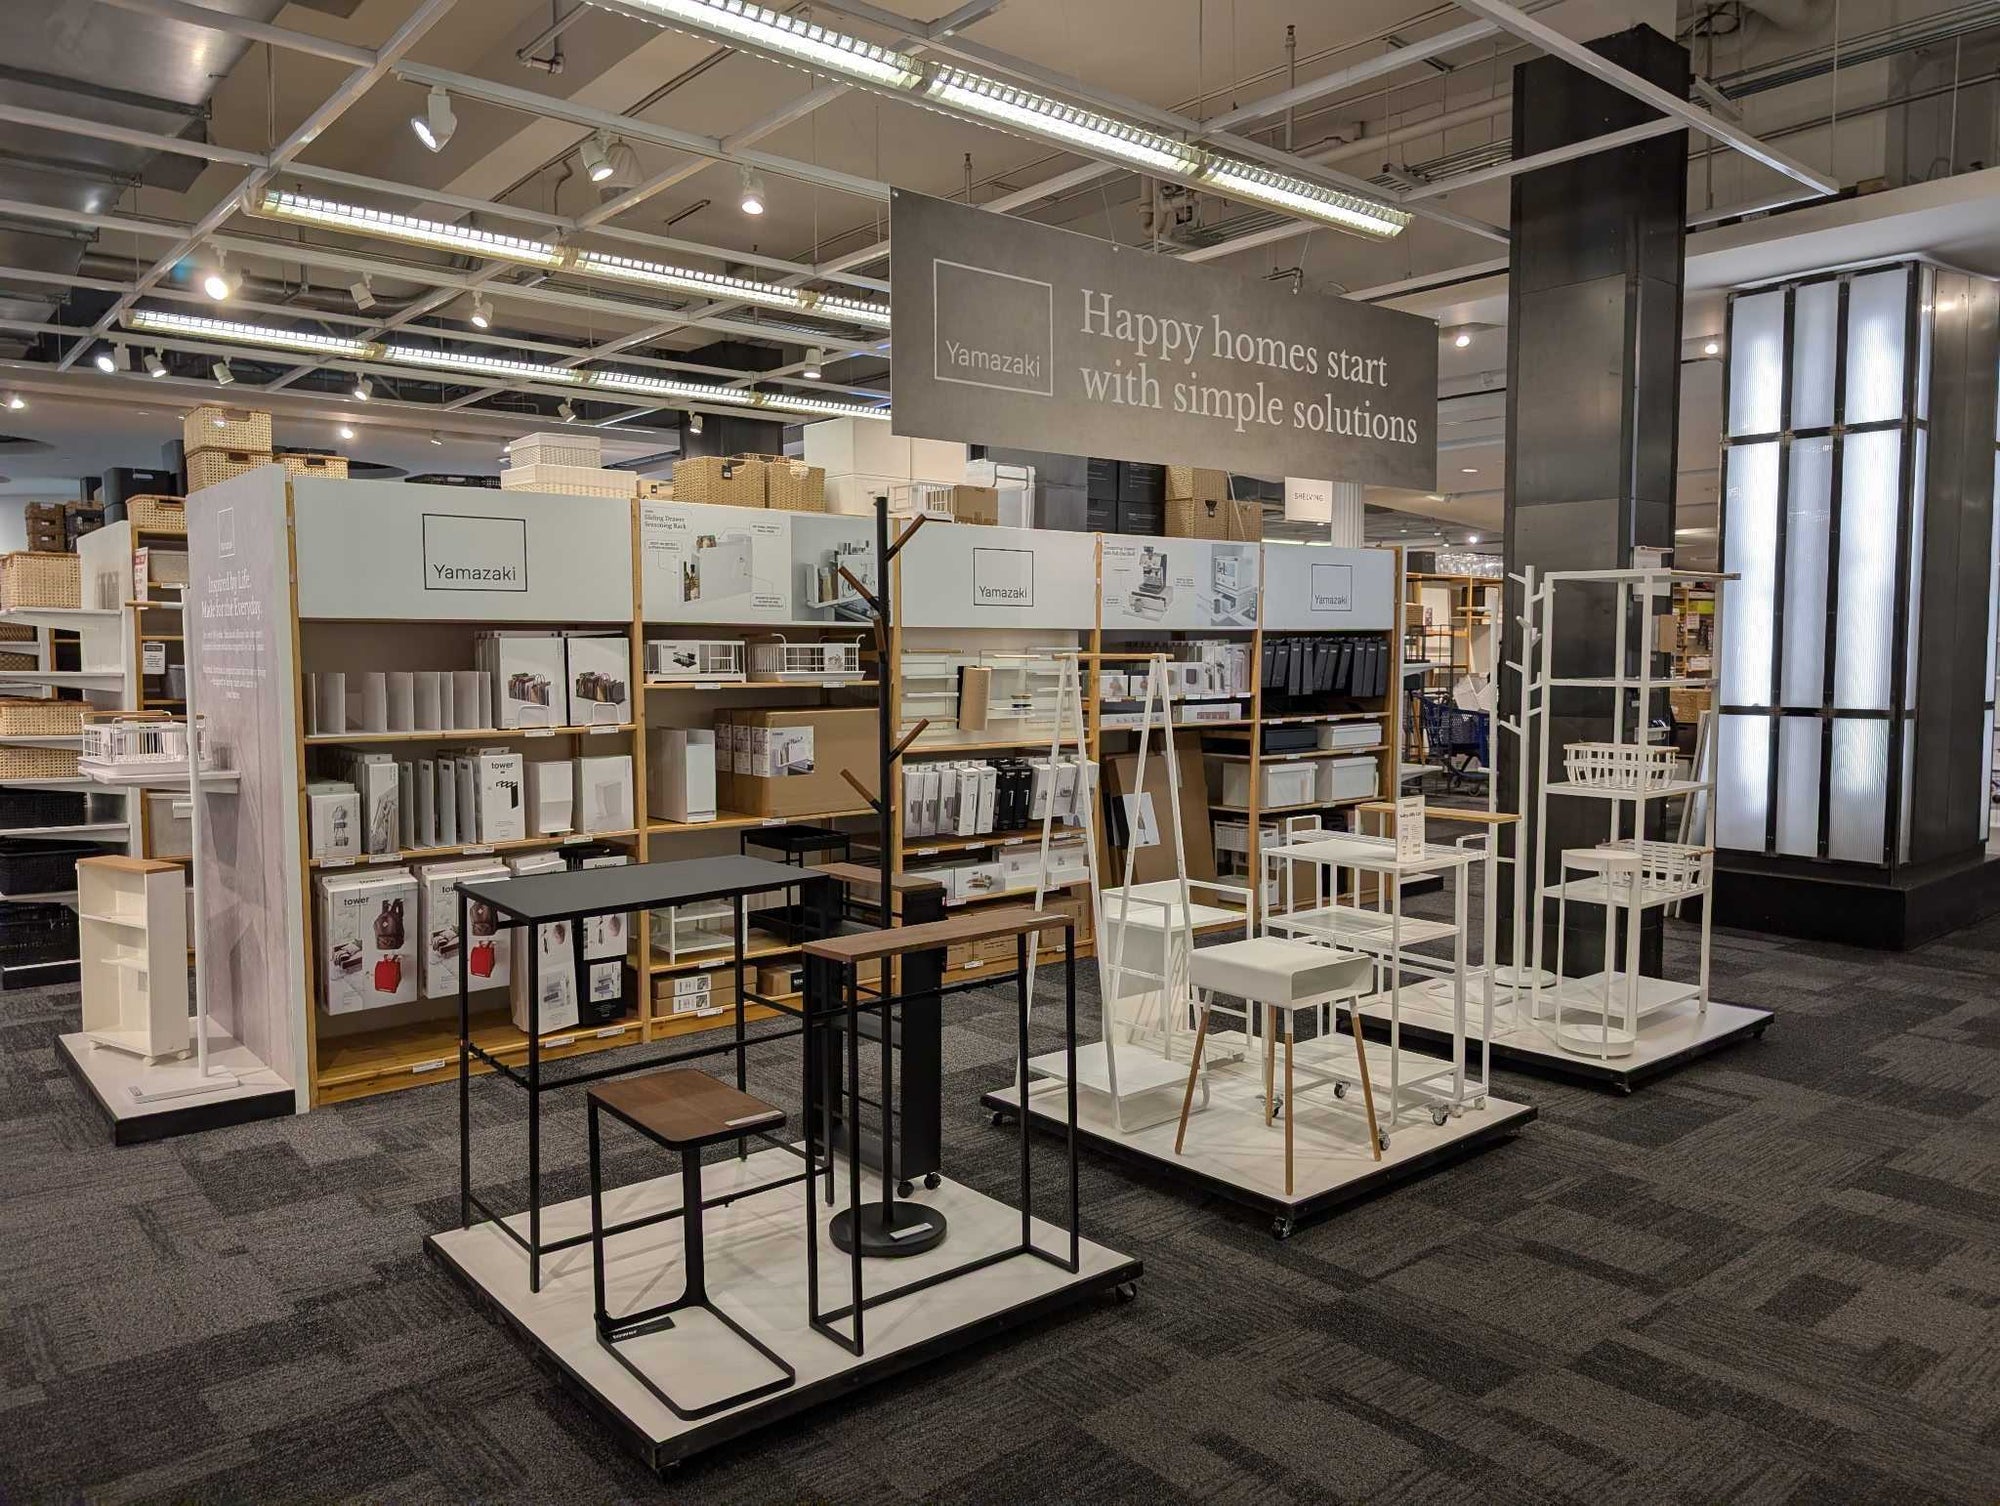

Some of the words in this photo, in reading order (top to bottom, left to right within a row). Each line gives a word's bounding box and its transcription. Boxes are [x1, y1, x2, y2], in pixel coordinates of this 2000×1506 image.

[1080, 288, 1204, 365] Happy
[1213, 314, 1319, 376] homes
[1326, 349, 1389, 388] start
[945, 340, 1041, 379] Yamazaki
[1080, 358, 1162, 411] with
[1173, 371, 1284, 434] simple
[1292, 394, 1419, 445] solutions
[433, 563, 517, 581] Yamazaki
[979, 585, 1028, 599] Yamazaki
[1314, 594, 1348, 605] Yamazaki
[344, 897, 370, 906] tower
